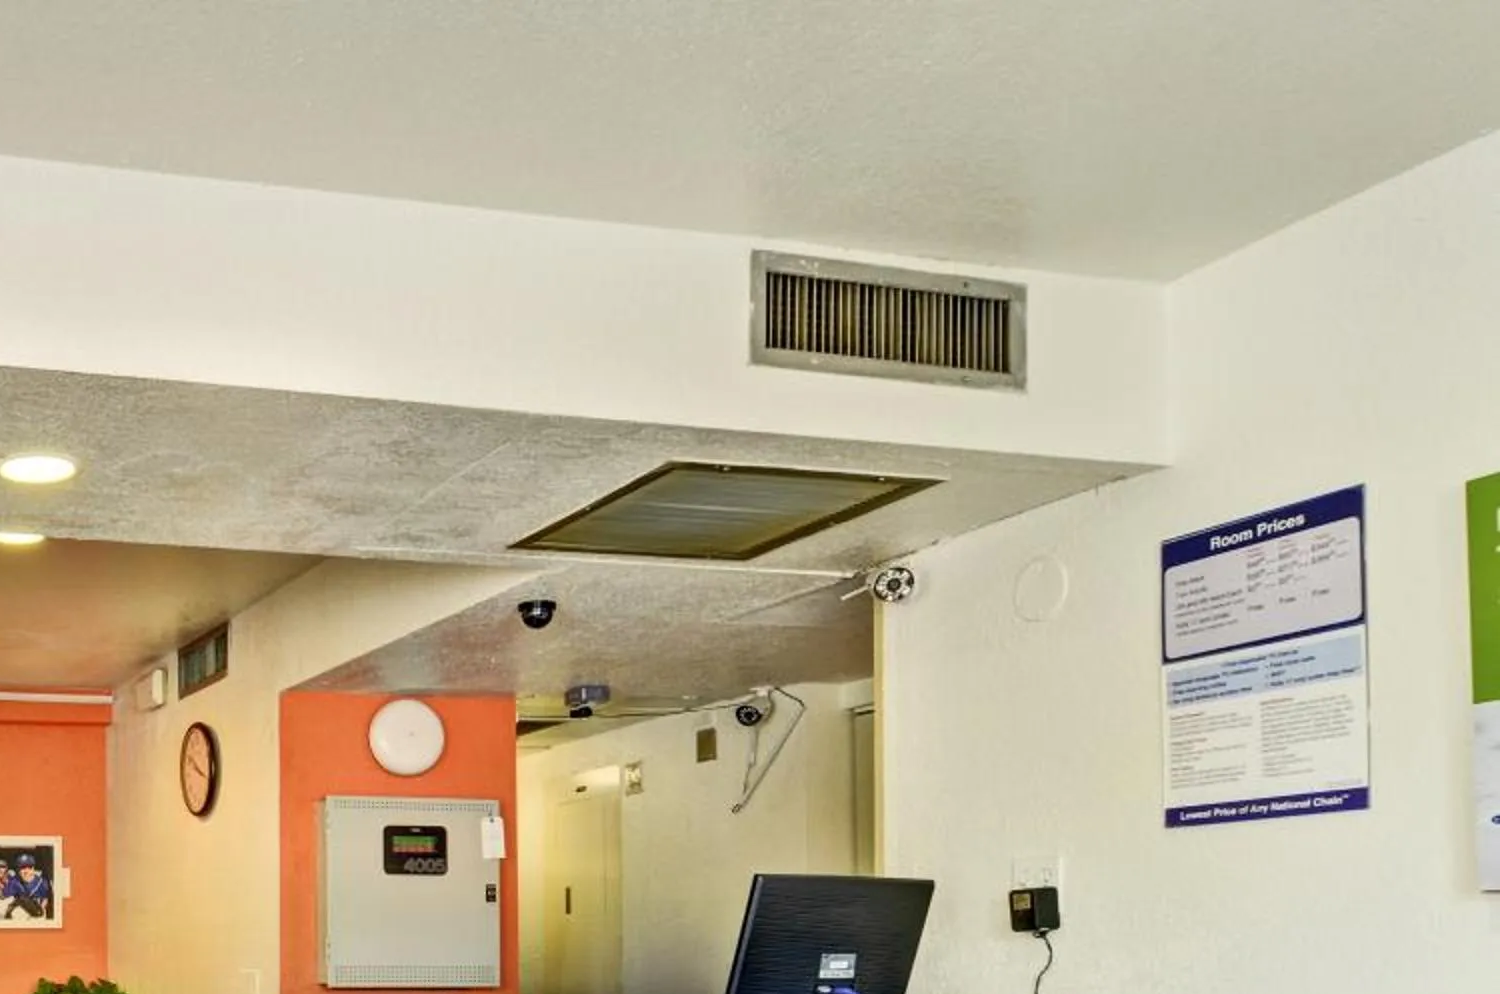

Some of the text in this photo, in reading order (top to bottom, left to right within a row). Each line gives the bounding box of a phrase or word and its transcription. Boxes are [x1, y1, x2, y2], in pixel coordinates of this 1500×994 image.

[1209, 514, 1305, 550] Room Prices
[1213, 808, 1237, 817] Price
[1238, 806, 1249, 815] of
[404, 858, 446, 873] 4005
